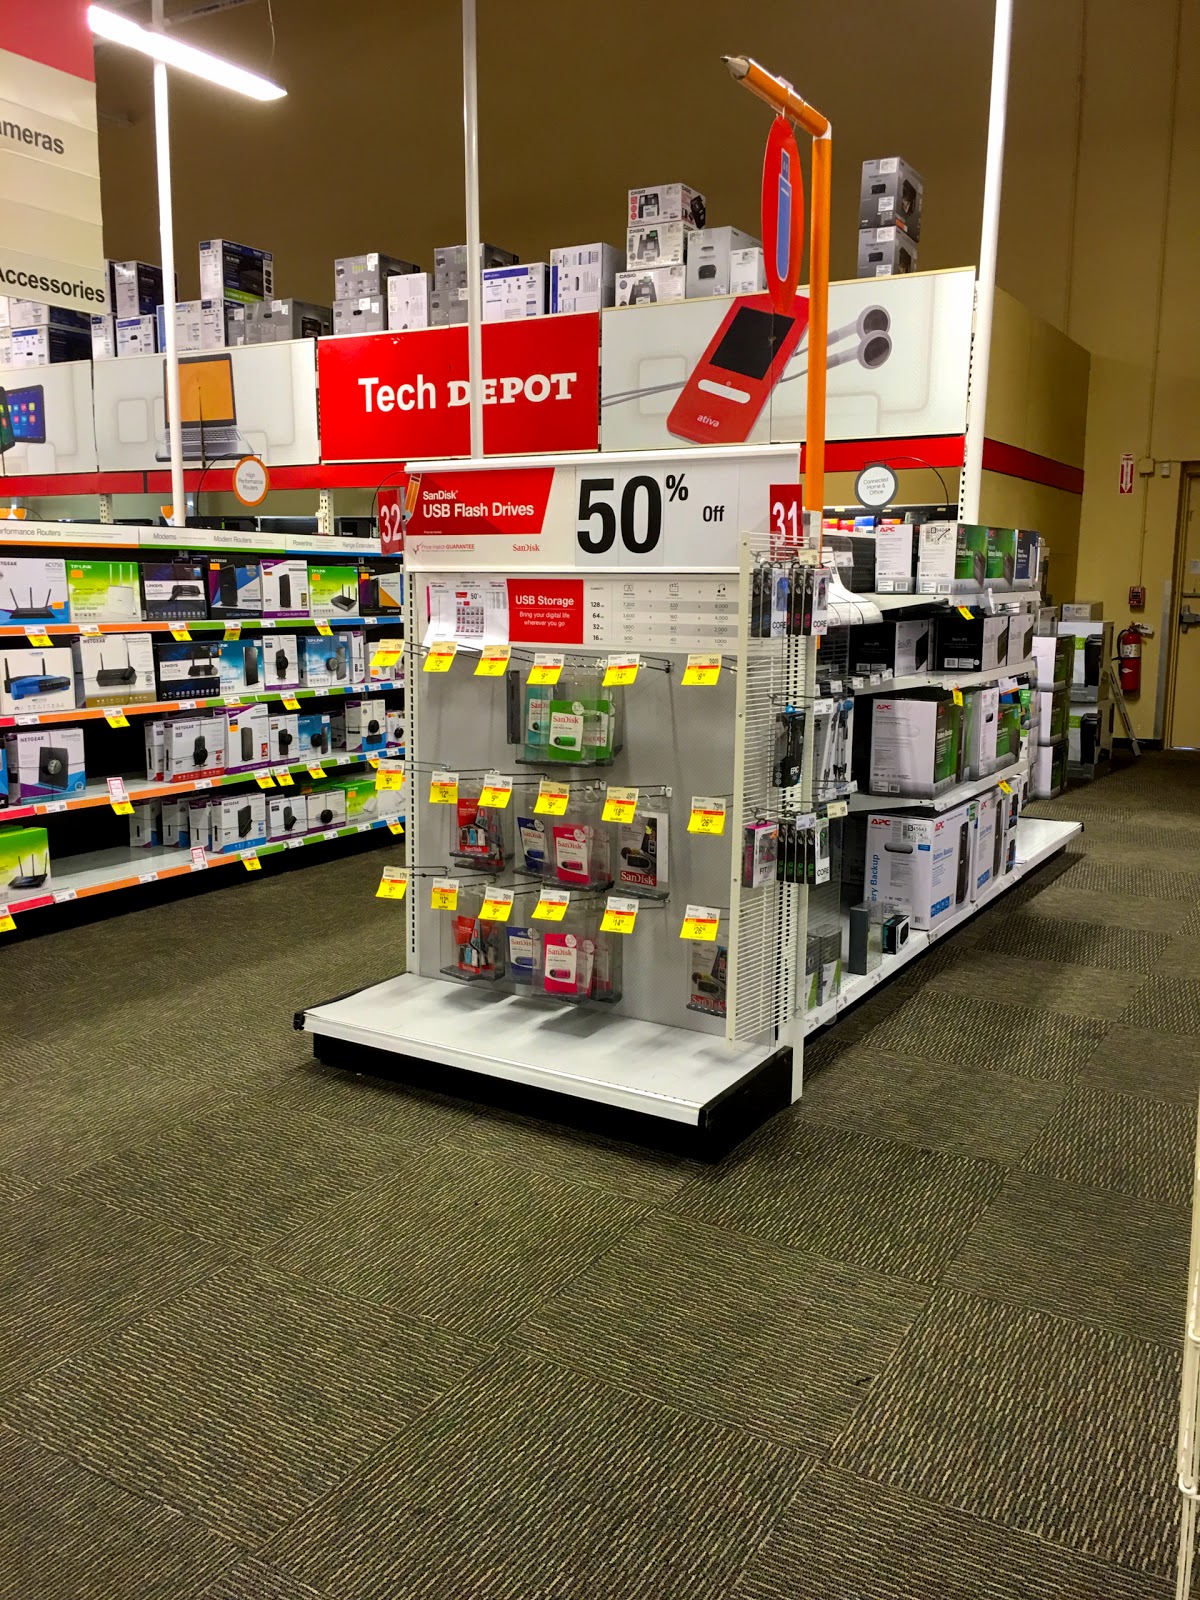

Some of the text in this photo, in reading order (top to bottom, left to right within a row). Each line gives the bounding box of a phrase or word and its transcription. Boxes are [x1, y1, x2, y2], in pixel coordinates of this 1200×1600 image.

[0, 119, 64, 155] meras
[358, 372, 577, 413] Tech DEPOT
[697, 414, 720, 428] ativa
[863, 477, 888, 485] Connected
[423, 502, 534, 518] USB Flash Drives
[703, 505, 725, 522] Off
[380, 503, 402, 544] 32
[772, 500, 798, 548] 31
[36, 529, 61, 537] Routers
[214, 535, 231, 543] Modem
[233, 536, 252, 544] Routers
[342, 541, 356, 549] Range
[515, 595, 575, 607] USB Storage
[519, 611, 533, 619] Bring
[545, 611, 561, 620] digital
[524, 619, 566, 628] wherever you go
[772, 621, 787, 629] CORE
[813, 620, 827, 628] CORE
[553, 716, 579, 724] SanDisk
[790, 766, 800, 775] EPIC
[870, 818, 891, 826] APC
[558, 841, 582, 849] SanDisk
[817, 867, 829, 877] CORE
[870, 854, 880, 886] Backup
[621, 871, 654, 886] SanDisk
[547, 948, 573, 956] SanDisk
